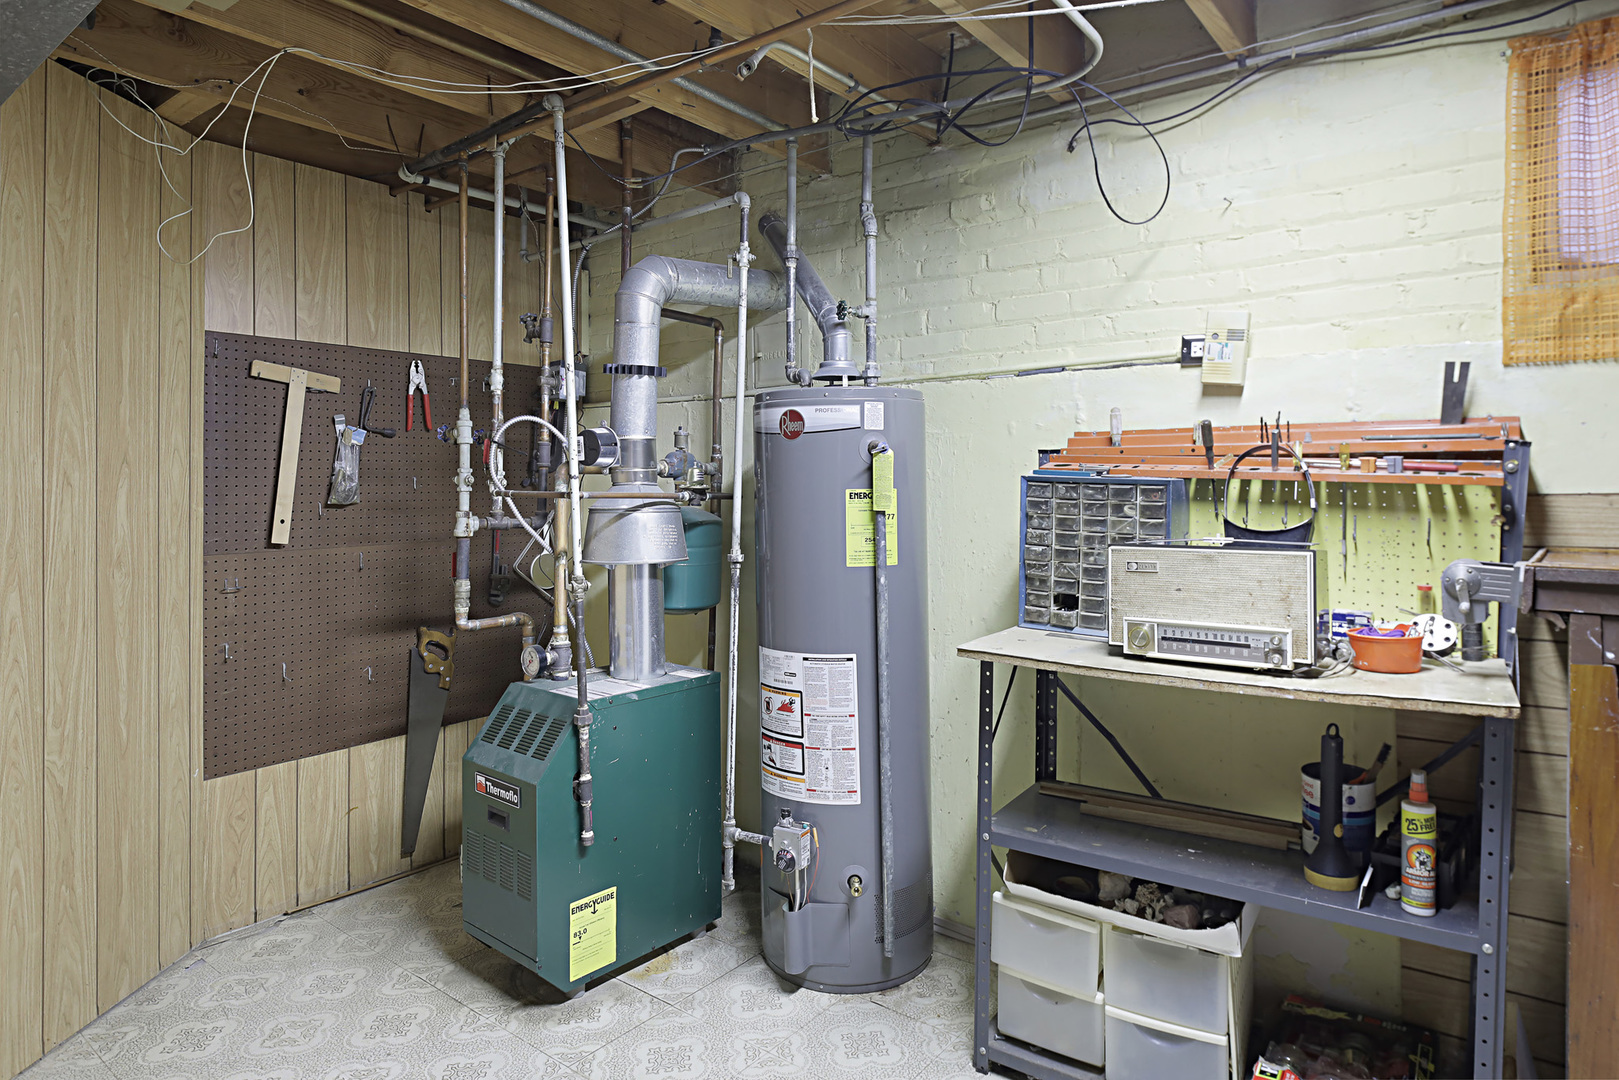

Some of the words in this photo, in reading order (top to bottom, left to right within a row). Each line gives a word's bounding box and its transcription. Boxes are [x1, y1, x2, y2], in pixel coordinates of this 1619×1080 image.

[781, 409, 803, 436] Rheem
[849, 492, 873, 500] ENERG
[486, 781, 518, 803] Thermoflo
[571, 891, 615, 915] ENERGYGUIDE
[573, 927, 588, 939] 83.0
